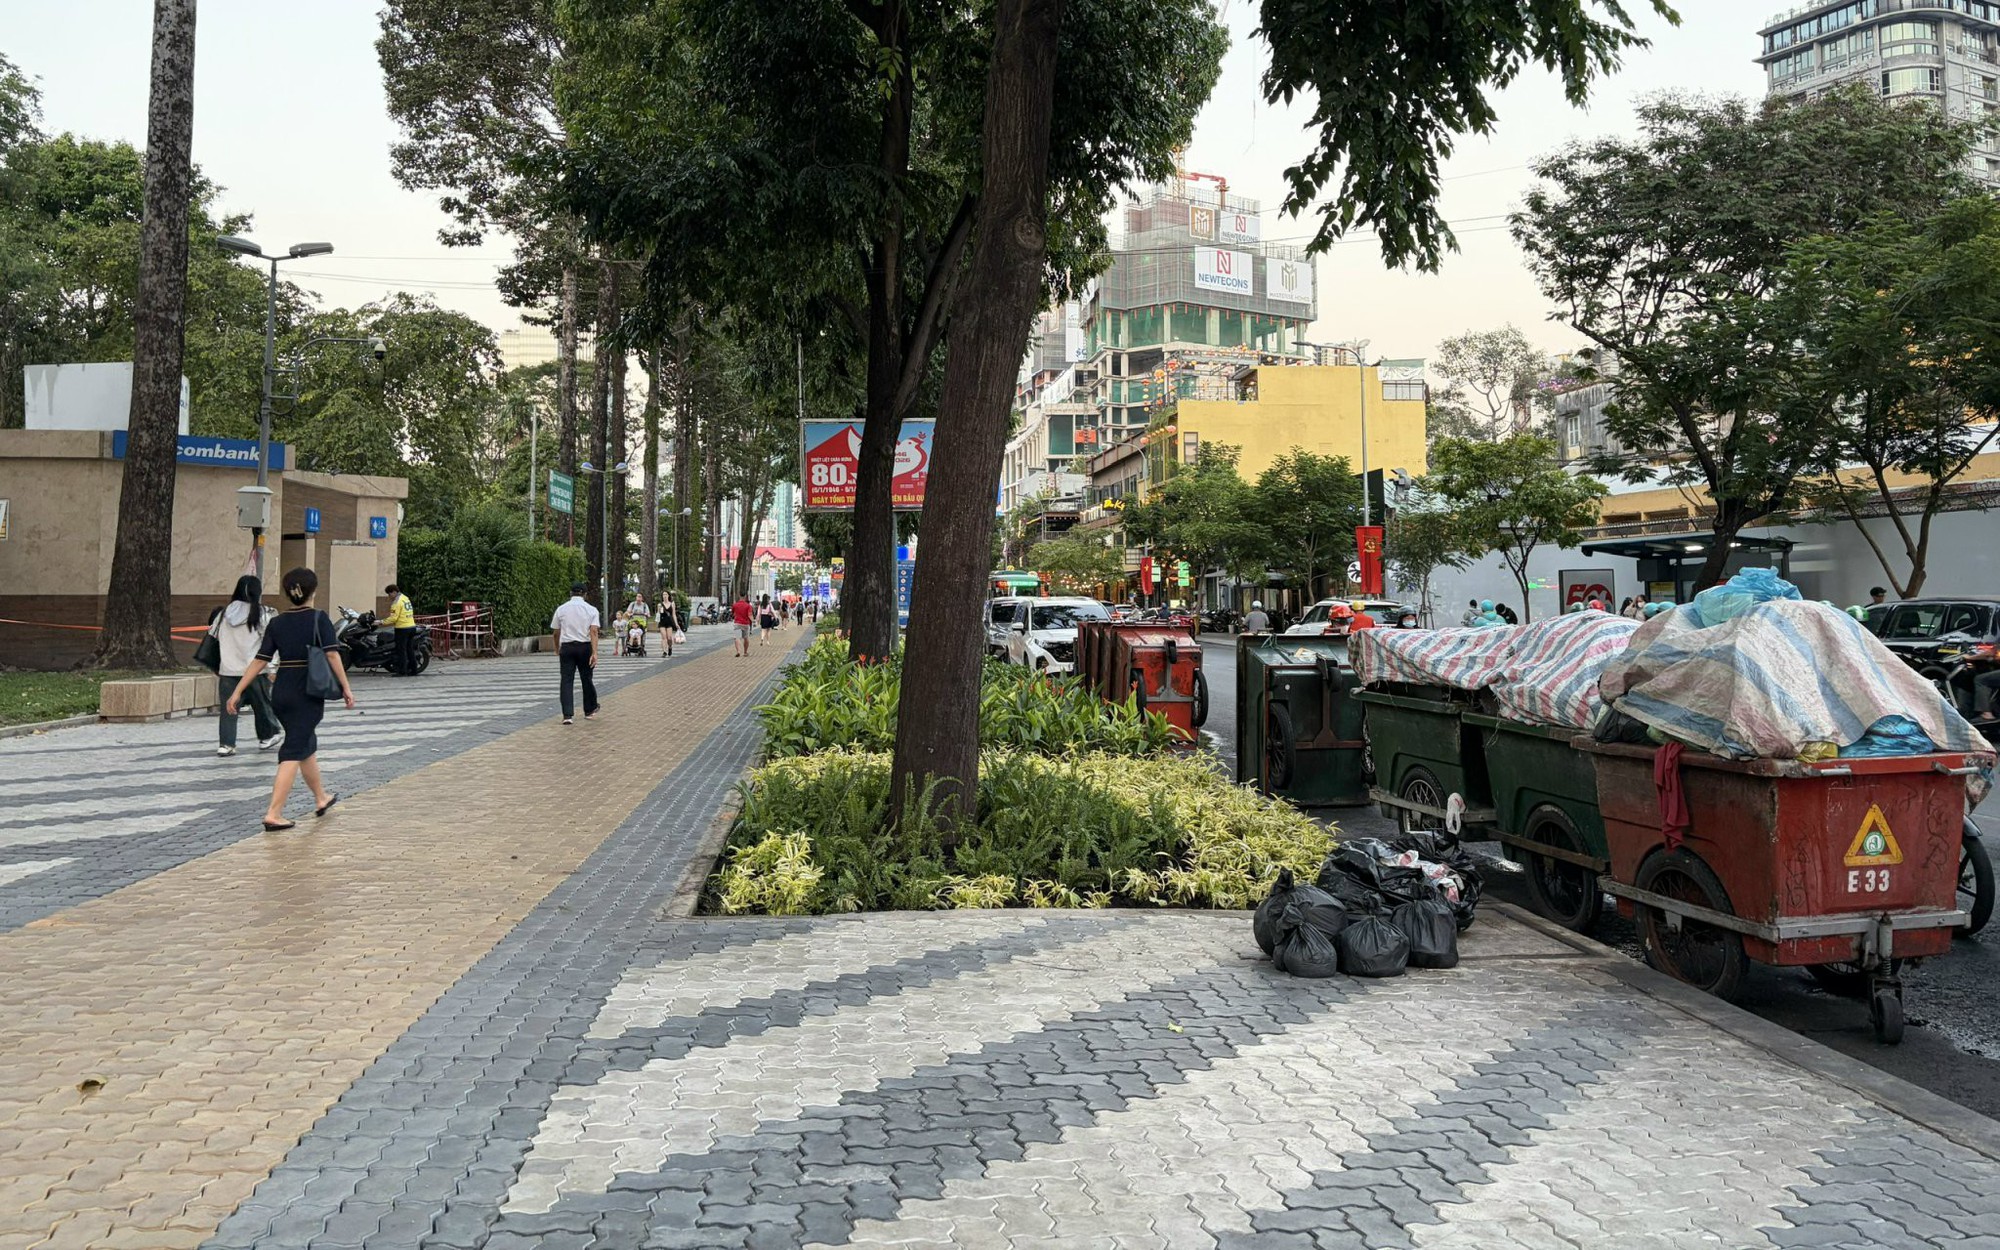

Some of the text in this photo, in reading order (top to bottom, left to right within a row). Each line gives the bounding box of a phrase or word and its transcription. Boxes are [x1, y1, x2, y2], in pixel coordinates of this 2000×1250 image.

[1222, 232, 1258, 242] NEWTECONS
[1198, 273, 1248, 289] NEWTECONS
[812, 464, 847, 486] 80
[812, 496, 828, 504] NGÀY
[1848, 870, 1889, 892] E 33
